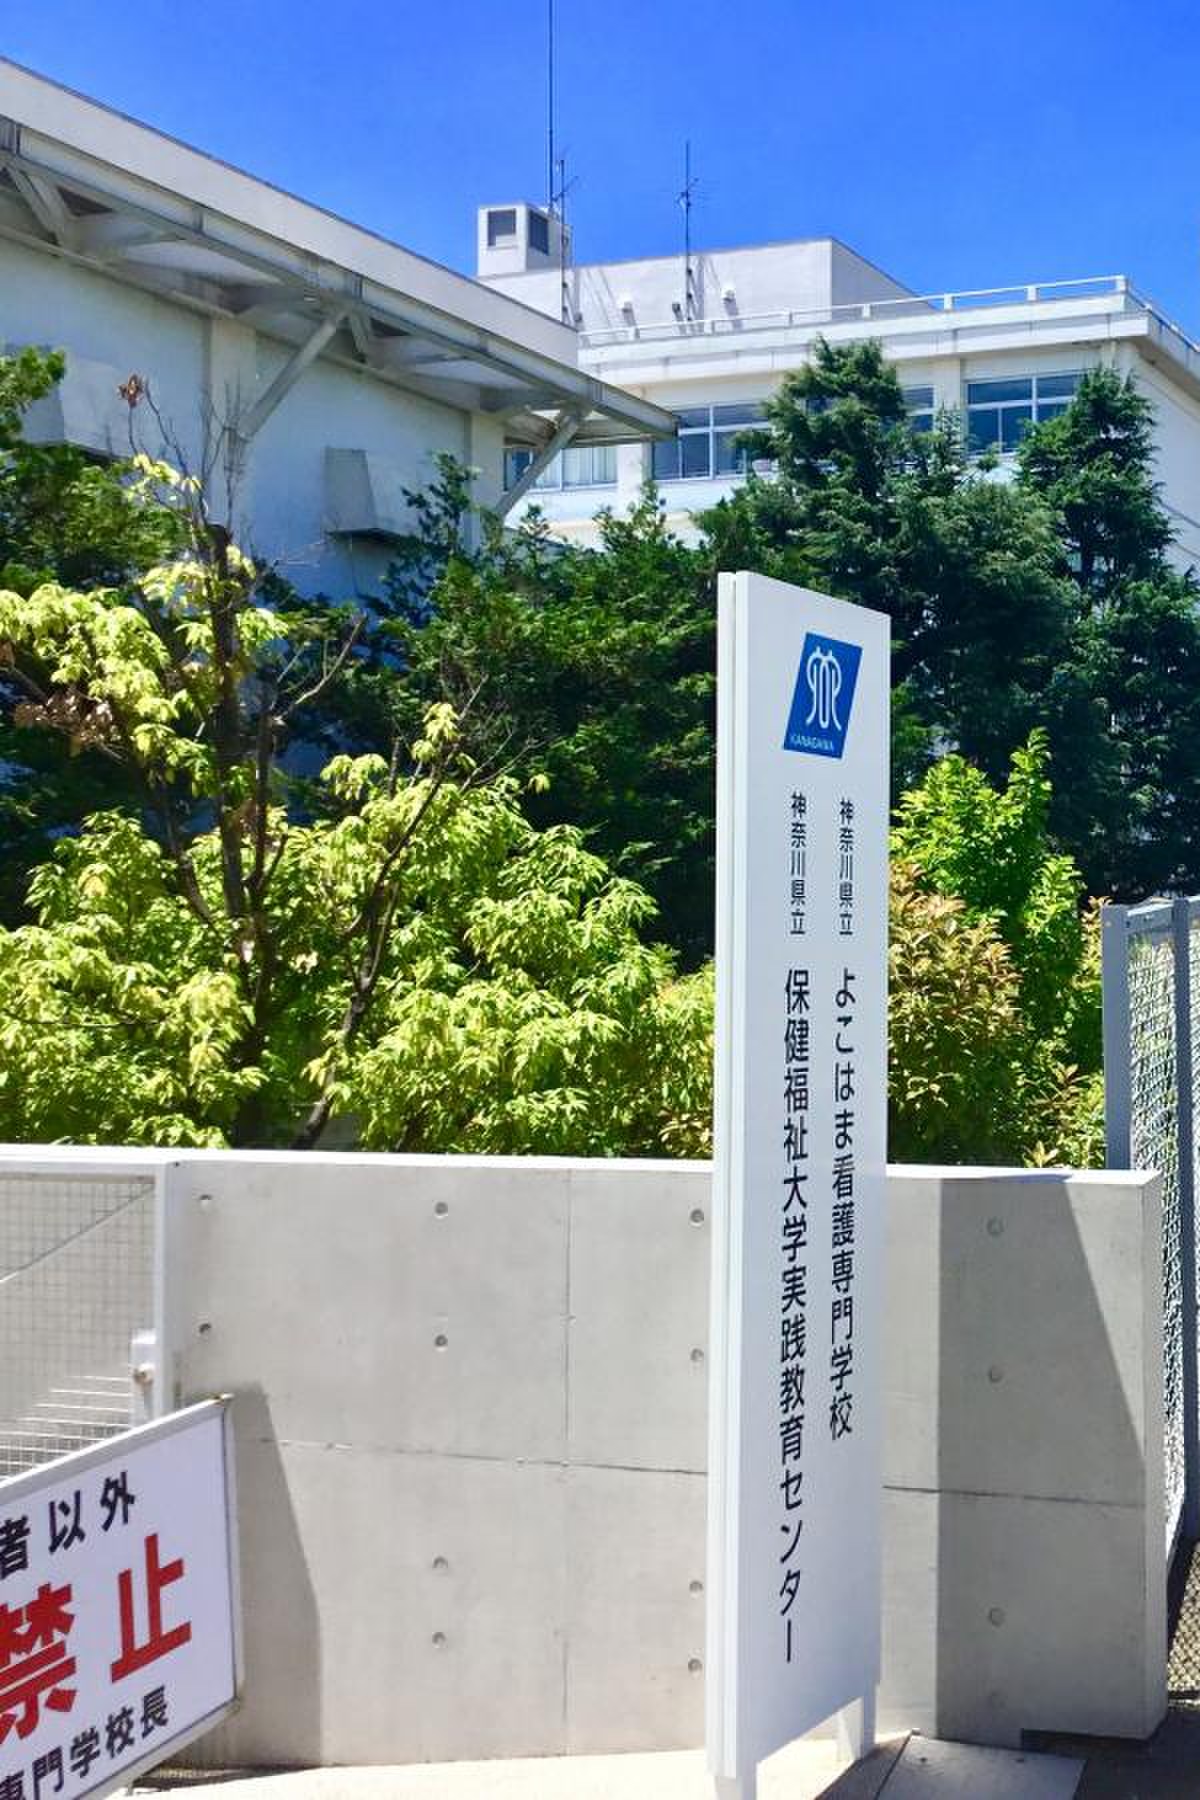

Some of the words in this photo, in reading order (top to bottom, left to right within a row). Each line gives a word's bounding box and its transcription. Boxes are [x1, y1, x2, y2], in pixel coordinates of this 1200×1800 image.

[789, 793, 807, 936] 神奈川県立
[838, 800, 854, 936] 神奈川県立
[829, 967, 856, 1441] よこはま看護専門学校
[779, 968, 810, 1664] 保健福祉大学実践教育センター
[0, 1471, 135, 1580] 者以外
[0, 1533, 192, 1742] 禁止
